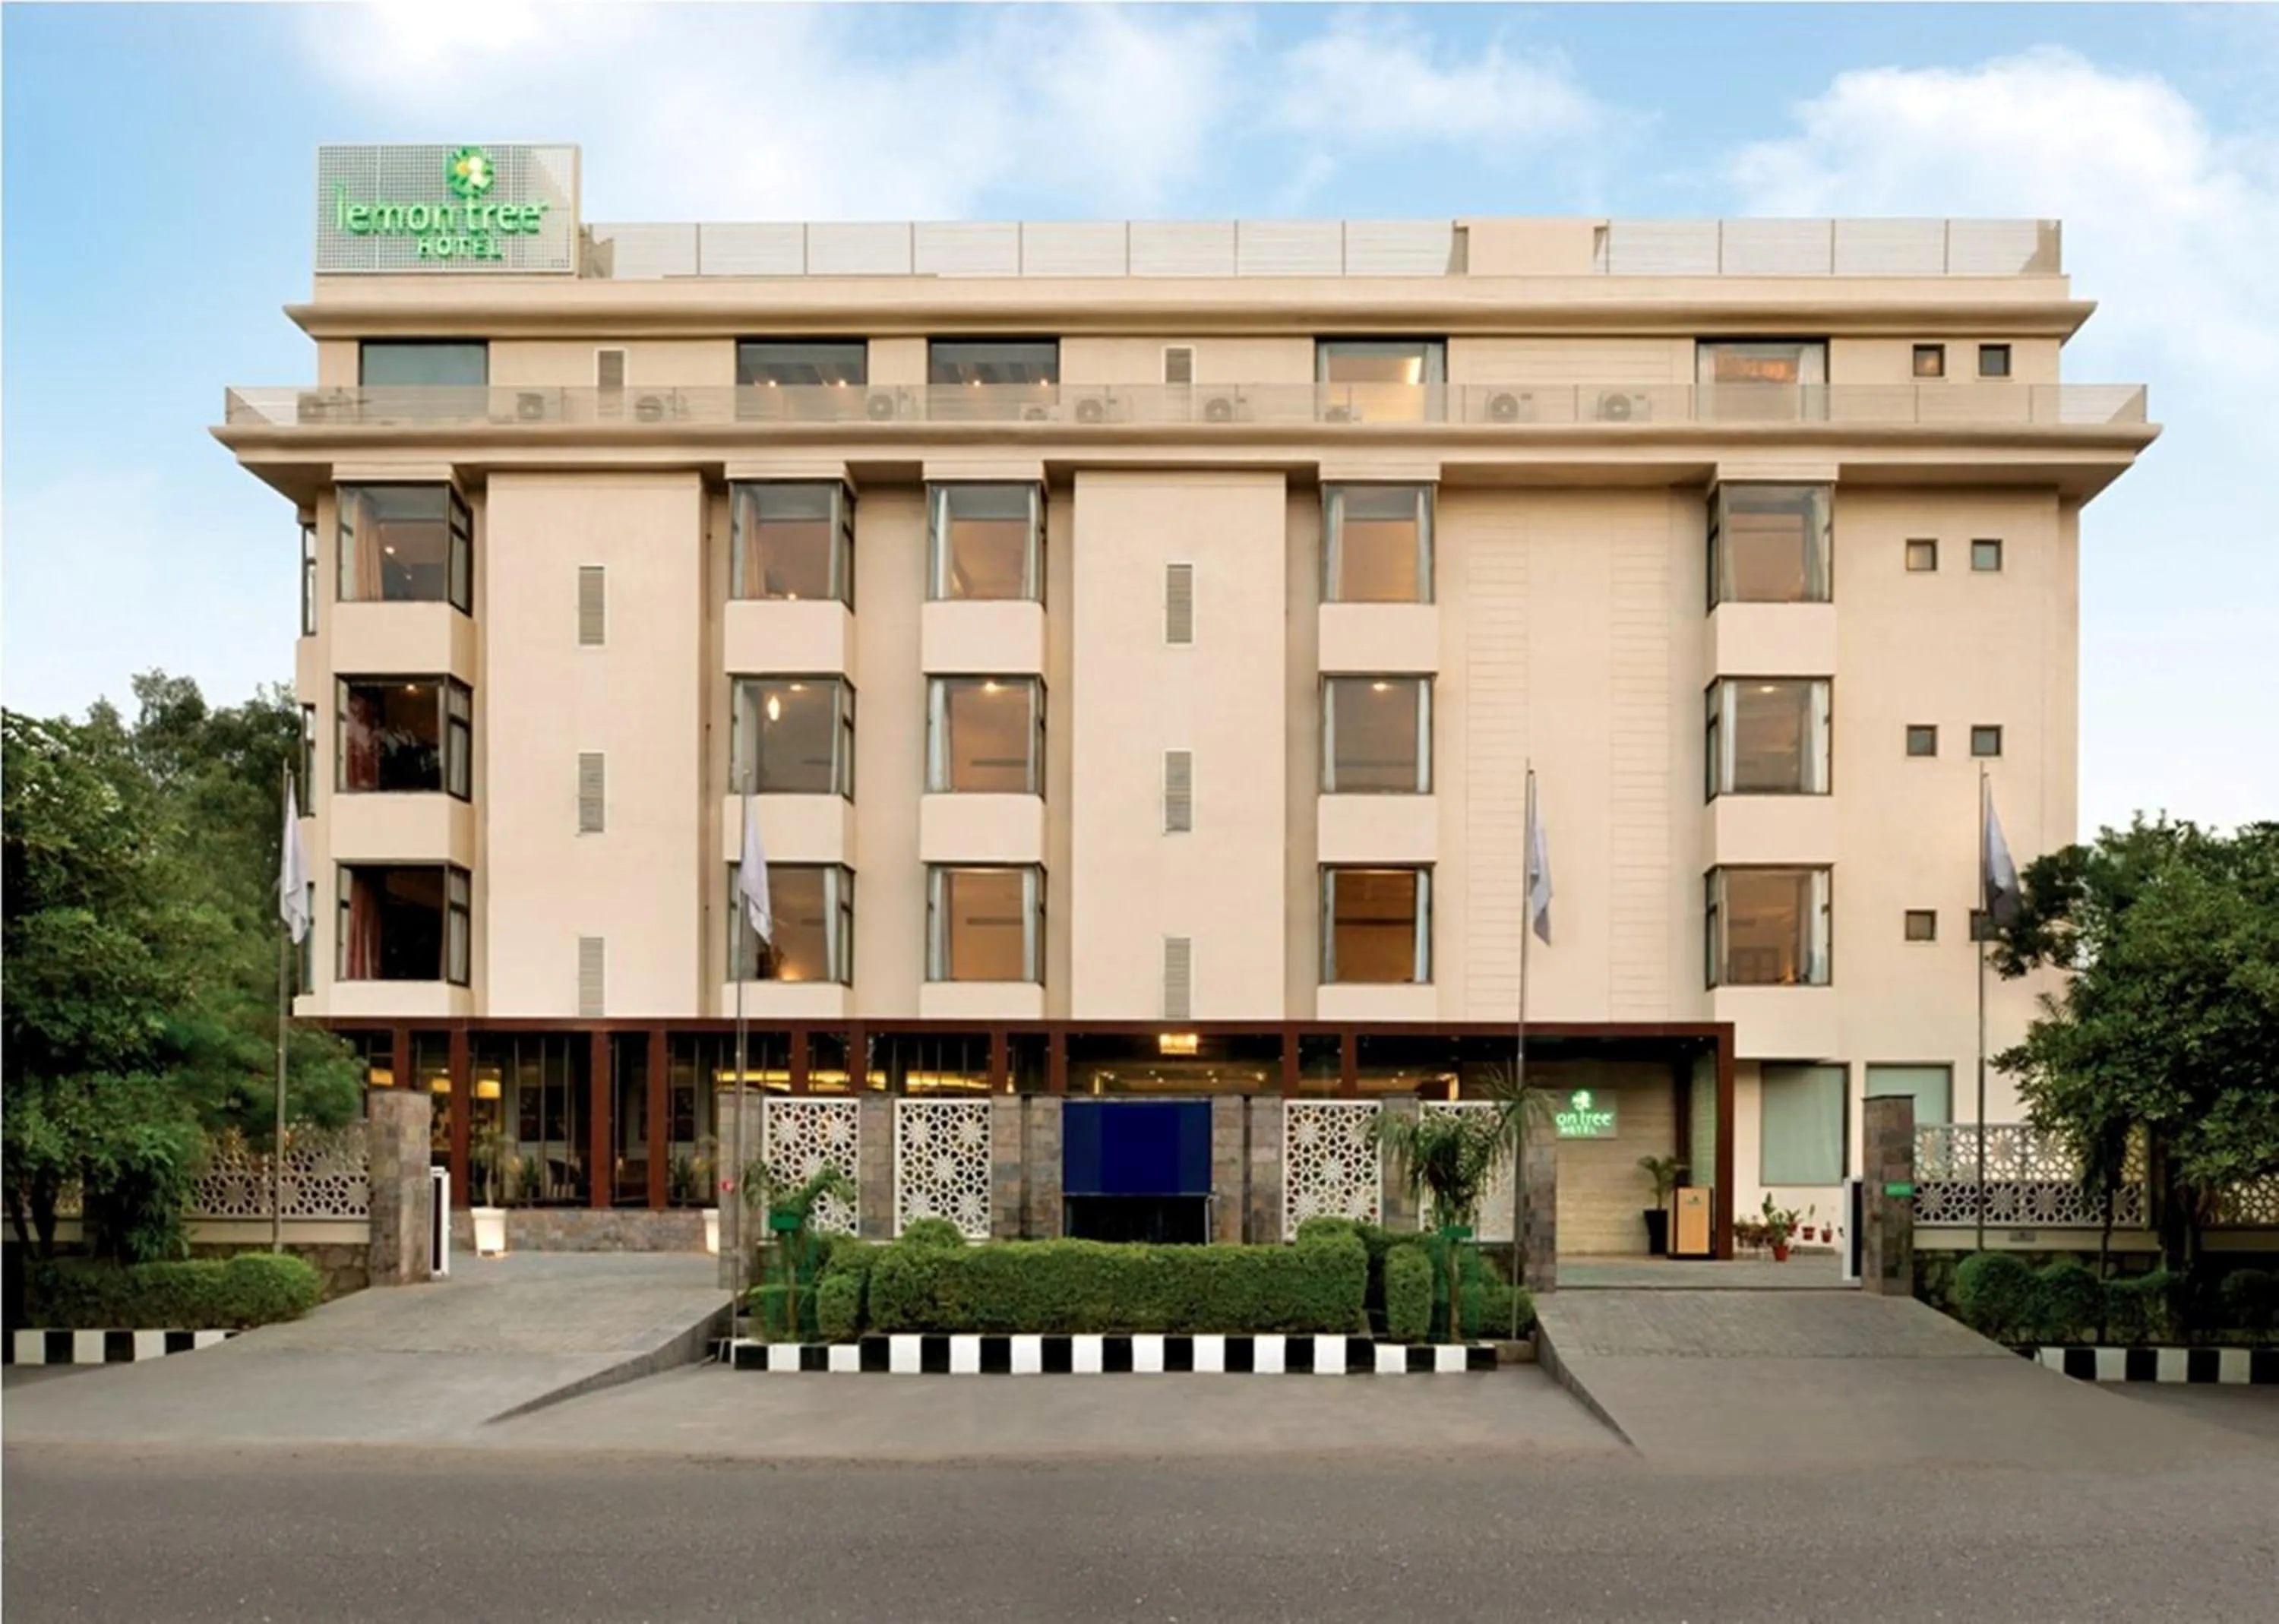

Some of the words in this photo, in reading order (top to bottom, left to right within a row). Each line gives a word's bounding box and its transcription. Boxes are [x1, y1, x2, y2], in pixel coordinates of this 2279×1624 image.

[334, 180, 456, 235] lemon
[465, 195, 540, 234] tree
[418, 236, 503, 260] HOTEL
